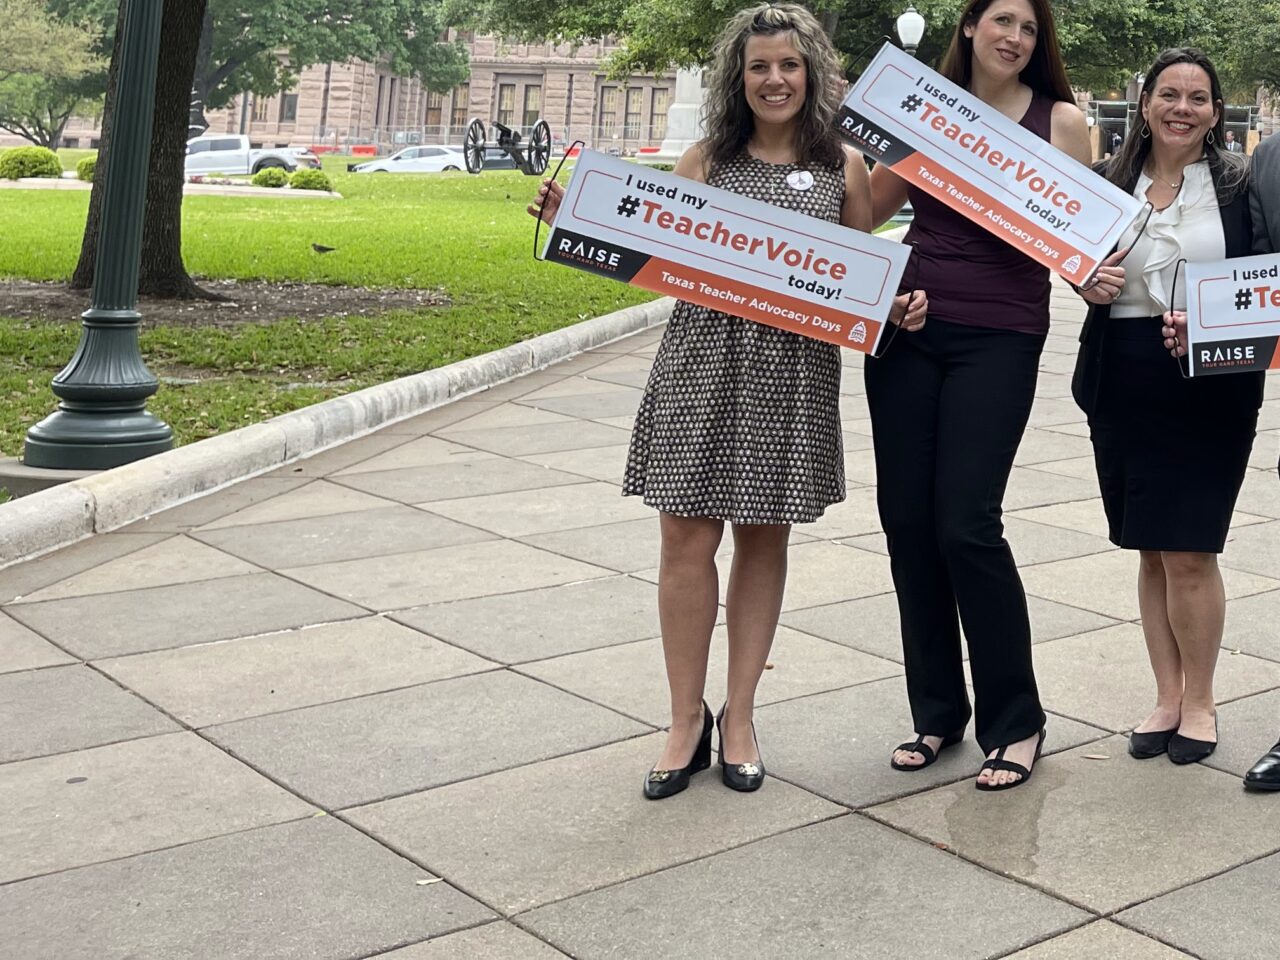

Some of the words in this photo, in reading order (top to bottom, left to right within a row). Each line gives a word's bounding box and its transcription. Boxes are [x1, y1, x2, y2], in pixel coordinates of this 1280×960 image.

[916, 76, 924, 86] I
[924, 82, 959, 108] used
[957, 104, 980, 122] my
[841, 116, 892, 152] RAISE
[900, 93, 1082, 216] #TeacherVoice
[625, 174, 633, 186] I
[636, 176, 678, 199] used
[680, 192, 708, 210] my
[918, 166, 944, 189] Texas
[946, 183, 984, 212] Teacher
[986, 209, 1034, 243] Advocacy
[1034, 239, 1060, 260] Days
[1025, 198, 1072, 232] today!
[558, 238, 621, 267] RAISE
[616, 195, 847, 280] #TeacherVoice
[788, 274, 842, 300] today!
[1233, 269, 1237, 281] I
[1243, 265, 1278, 280] used
[661, 271, 696, 290] Texas
[699, 282, 747, 305] Teacher
[749, 298, 810, 325] Advocacy
[812, 315, 842, 333] Days
[1201, 346, 1255, 362] RAISE
